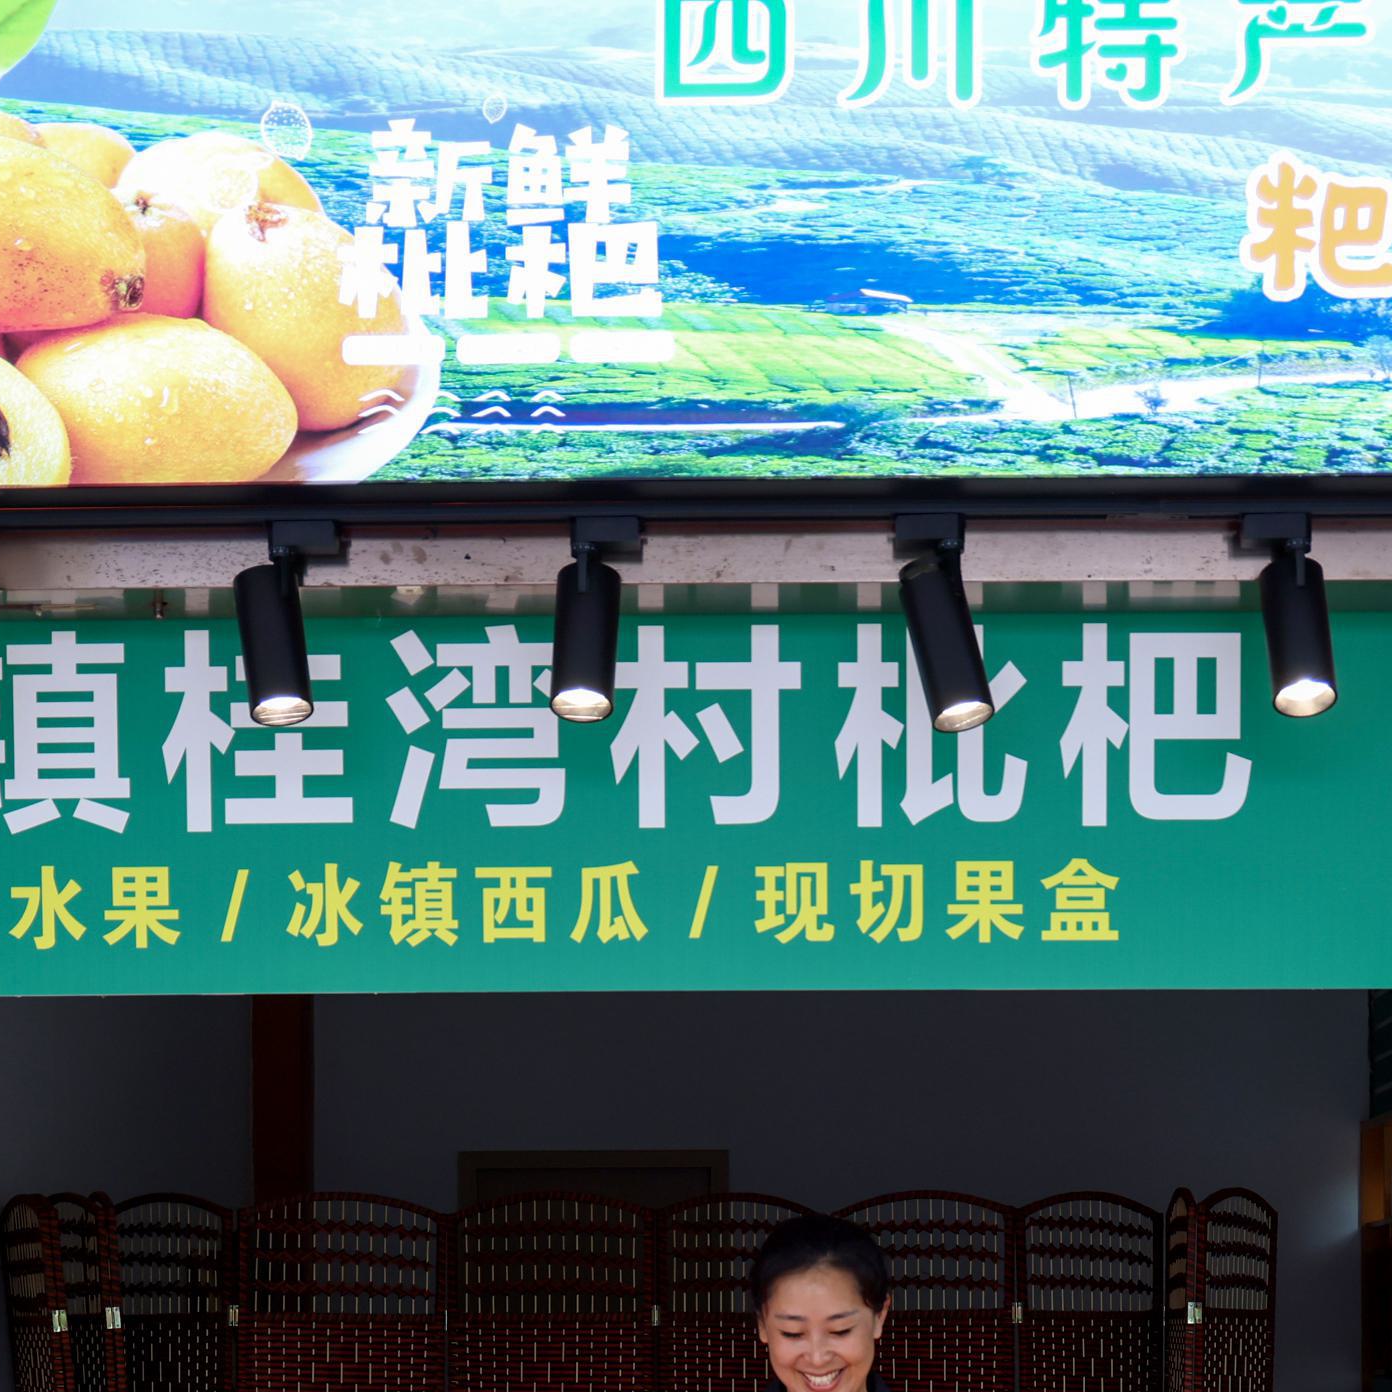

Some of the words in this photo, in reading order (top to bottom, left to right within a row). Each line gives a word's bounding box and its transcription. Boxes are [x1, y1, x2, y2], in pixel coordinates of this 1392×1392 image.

[661, 0, 1370, 105] 四川特产
[365, 117, 632, 227] 新鲜
[337, 219, 664, 320] 枇杷
[285, 860, 649, 948] 冰镇西瓜
[754, 857, 1120, 945] 现切果盒
